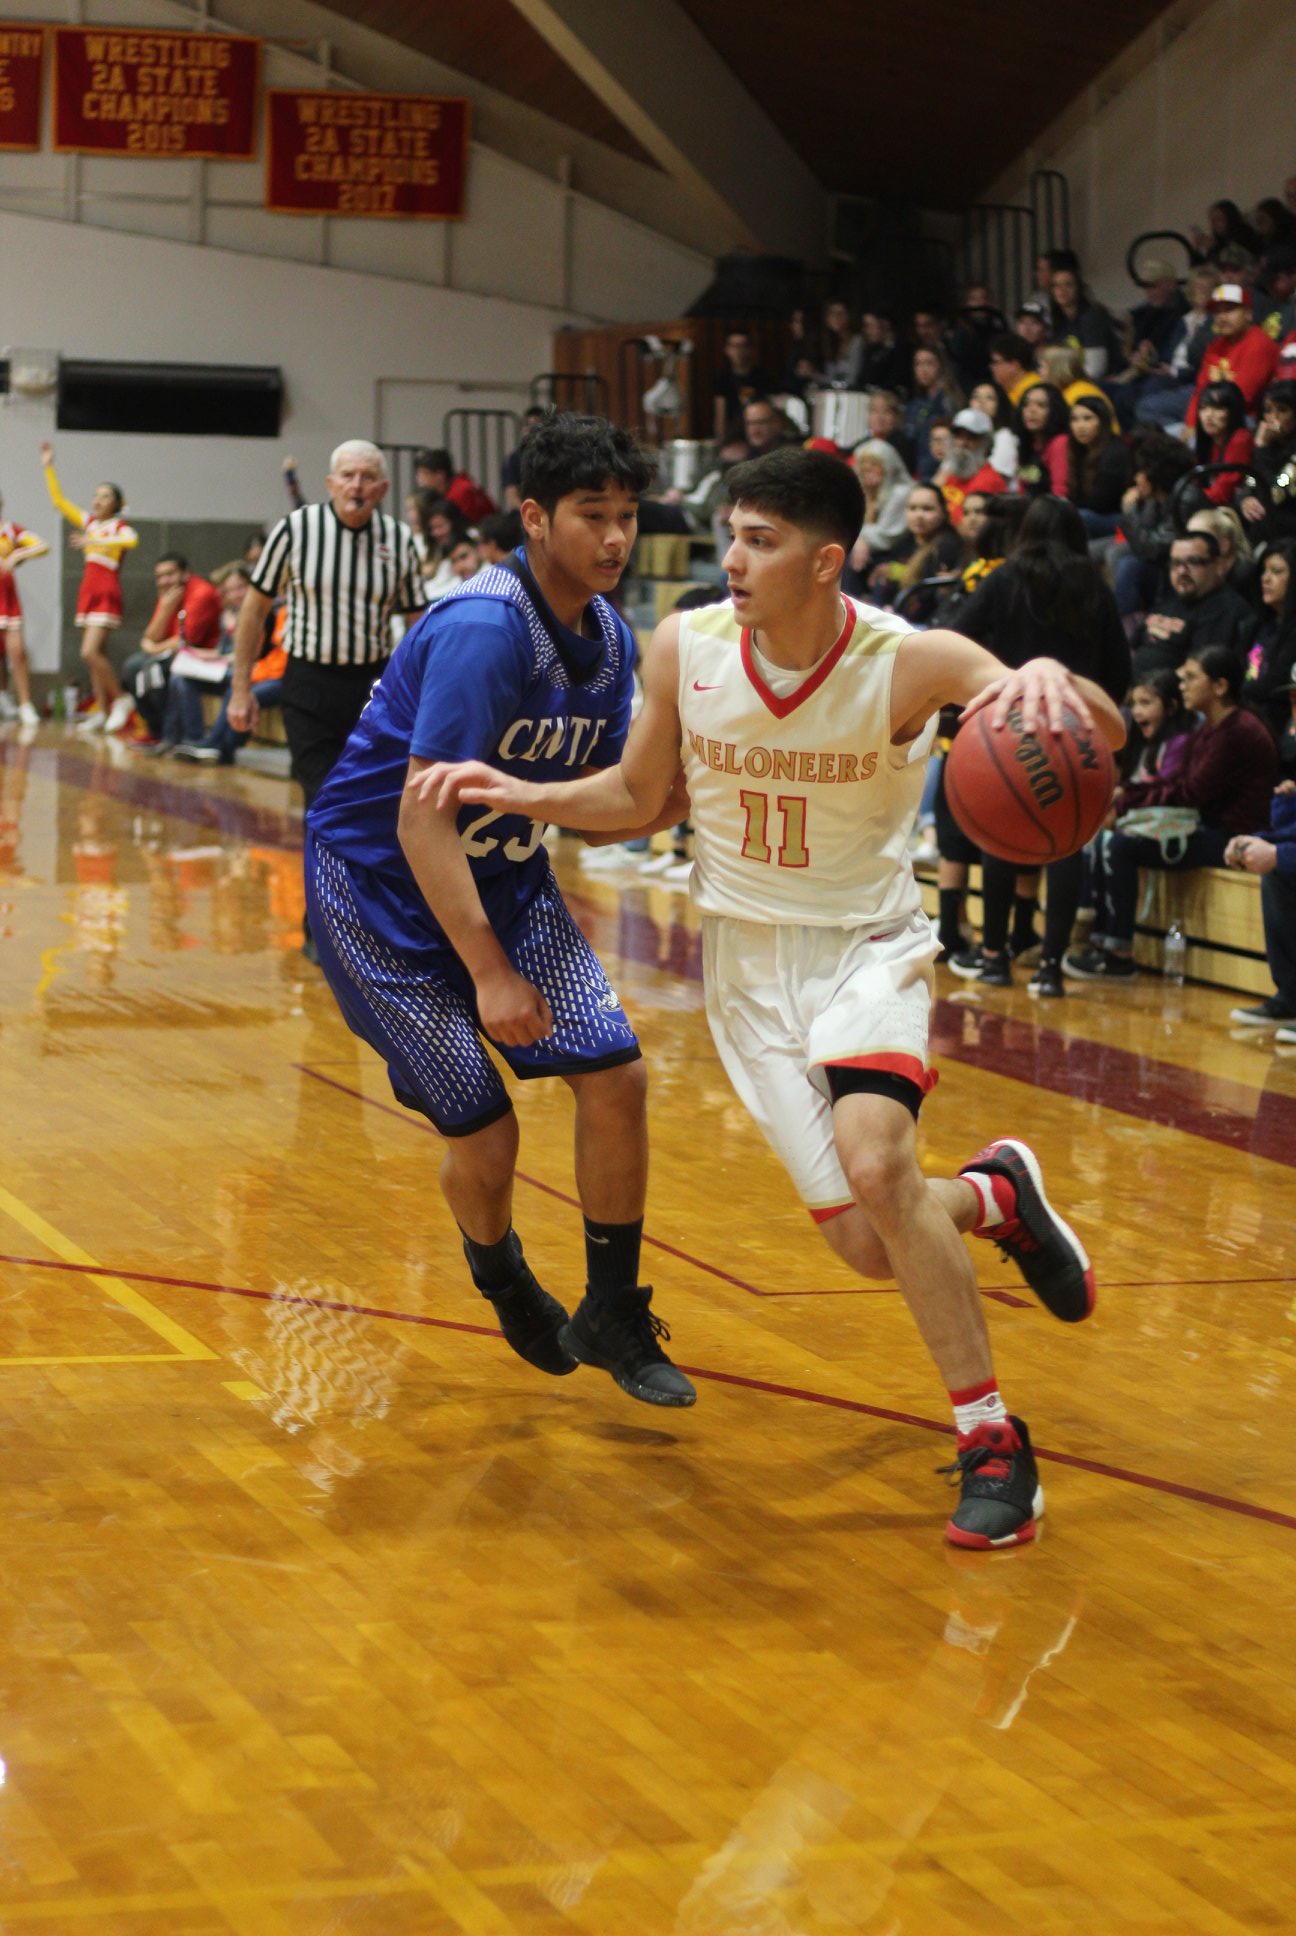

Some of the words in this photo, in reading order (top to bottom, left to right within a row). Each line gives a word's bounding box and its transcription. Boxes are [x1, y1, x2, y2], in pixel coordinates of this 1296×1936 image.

[85, 34, 231, 68] WRESTLING
[92, 62, 126, 91] 2A
[137, 66, 219, 95] STATE
[82, 92, 229, 124] CHAMPIONS
[297, 98, 440, 130] WRESTLING
[127, 122, 186, 150] 2015
[304, 125, 339, 152] 2A
[349, 127, 430, 157] STATE
[294, 154, 438, 185] CHAMPIONS
[338, 183, 396, 211] 2017
[688, 729, 878, 784] MELONEERS
[740, 789, 809, 868] 11
